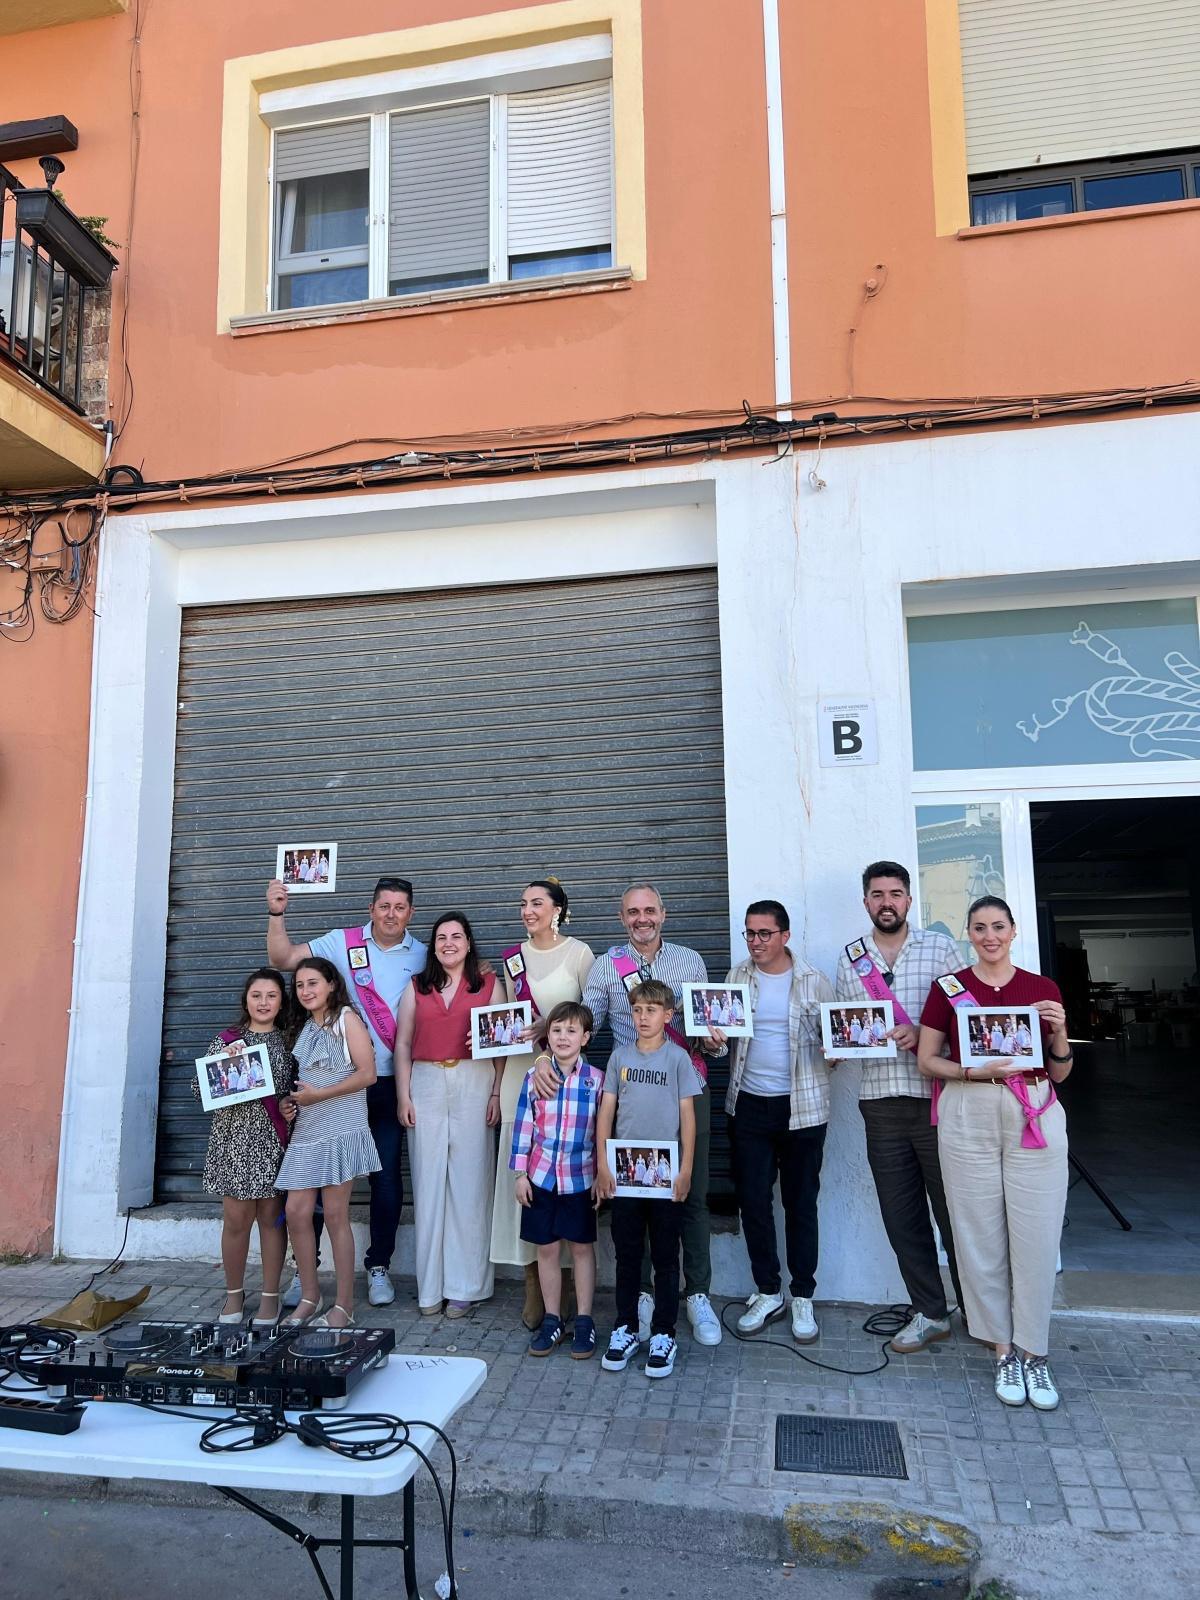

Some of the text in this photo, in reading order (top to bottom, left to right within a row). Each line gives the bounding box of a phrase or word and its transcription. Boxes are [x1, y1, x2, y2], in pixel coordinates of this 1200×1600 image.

[832, 720, 863, 755] B
[621, 1067, 667, 1086] HOODRICH
[156, 1366, 192, 1376] Pioneer
